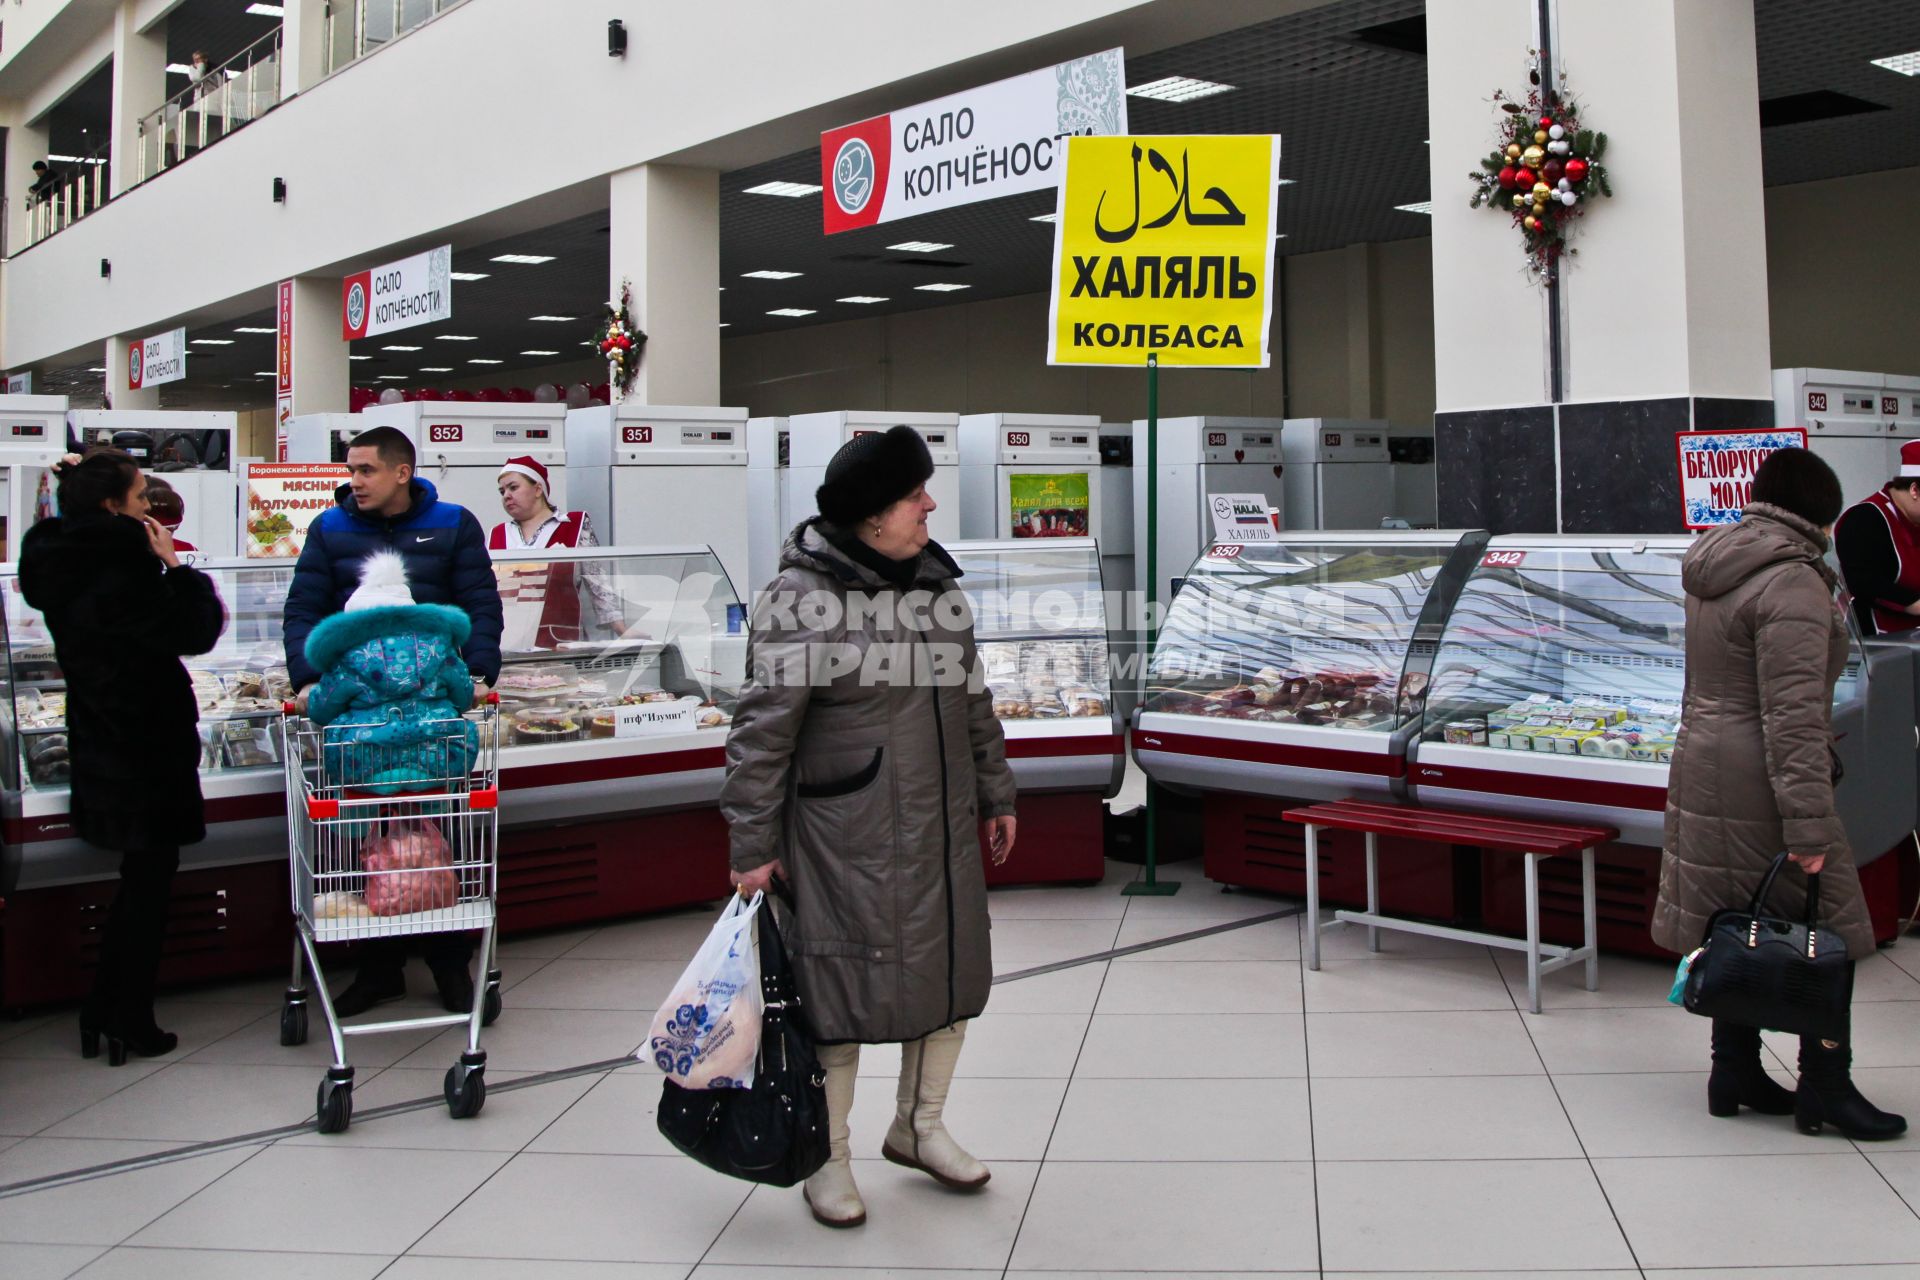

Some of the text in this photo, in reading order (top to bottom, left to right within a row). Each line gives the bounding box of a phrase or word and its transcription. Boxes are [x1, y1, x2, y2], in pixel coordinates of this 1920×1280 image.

[903, 107, 974, 153] САЛО
[904, 127, 1093, 201] КОПЧЁНОС
[1094, 141, 1246, 243] حلال
[375, 271, 402, 296] САЛО
[1070, 256, 1257, 299] ХАЛЯЛЬ
[375, 289, 440, 325] КОПЧЁНОСТИ
[1073, 322, 1244, 349] КОЛБАСА
[145, 342, 160, 358] САЛО
[1810, 395, 1825, 409] 342
[1883, 399, 1897, 412] 343
[433, 427, 460, 440] 352
[627, 429, 649, 441] 351
[1010, 433, 1028, 445] 350
[1210, 434, 1225, 445] 348
[250, 465, 307, 474] Воронежский
[283, 480, 338, 491] МЯСНЫЕ
[1233, 505, 1264, 514] HALAL
[1228, 529, 1270, 540] ХАЛЯЛЬ
[1211, 546, 1240, 557] 350
[1487, 551, 1522, 564] 342
